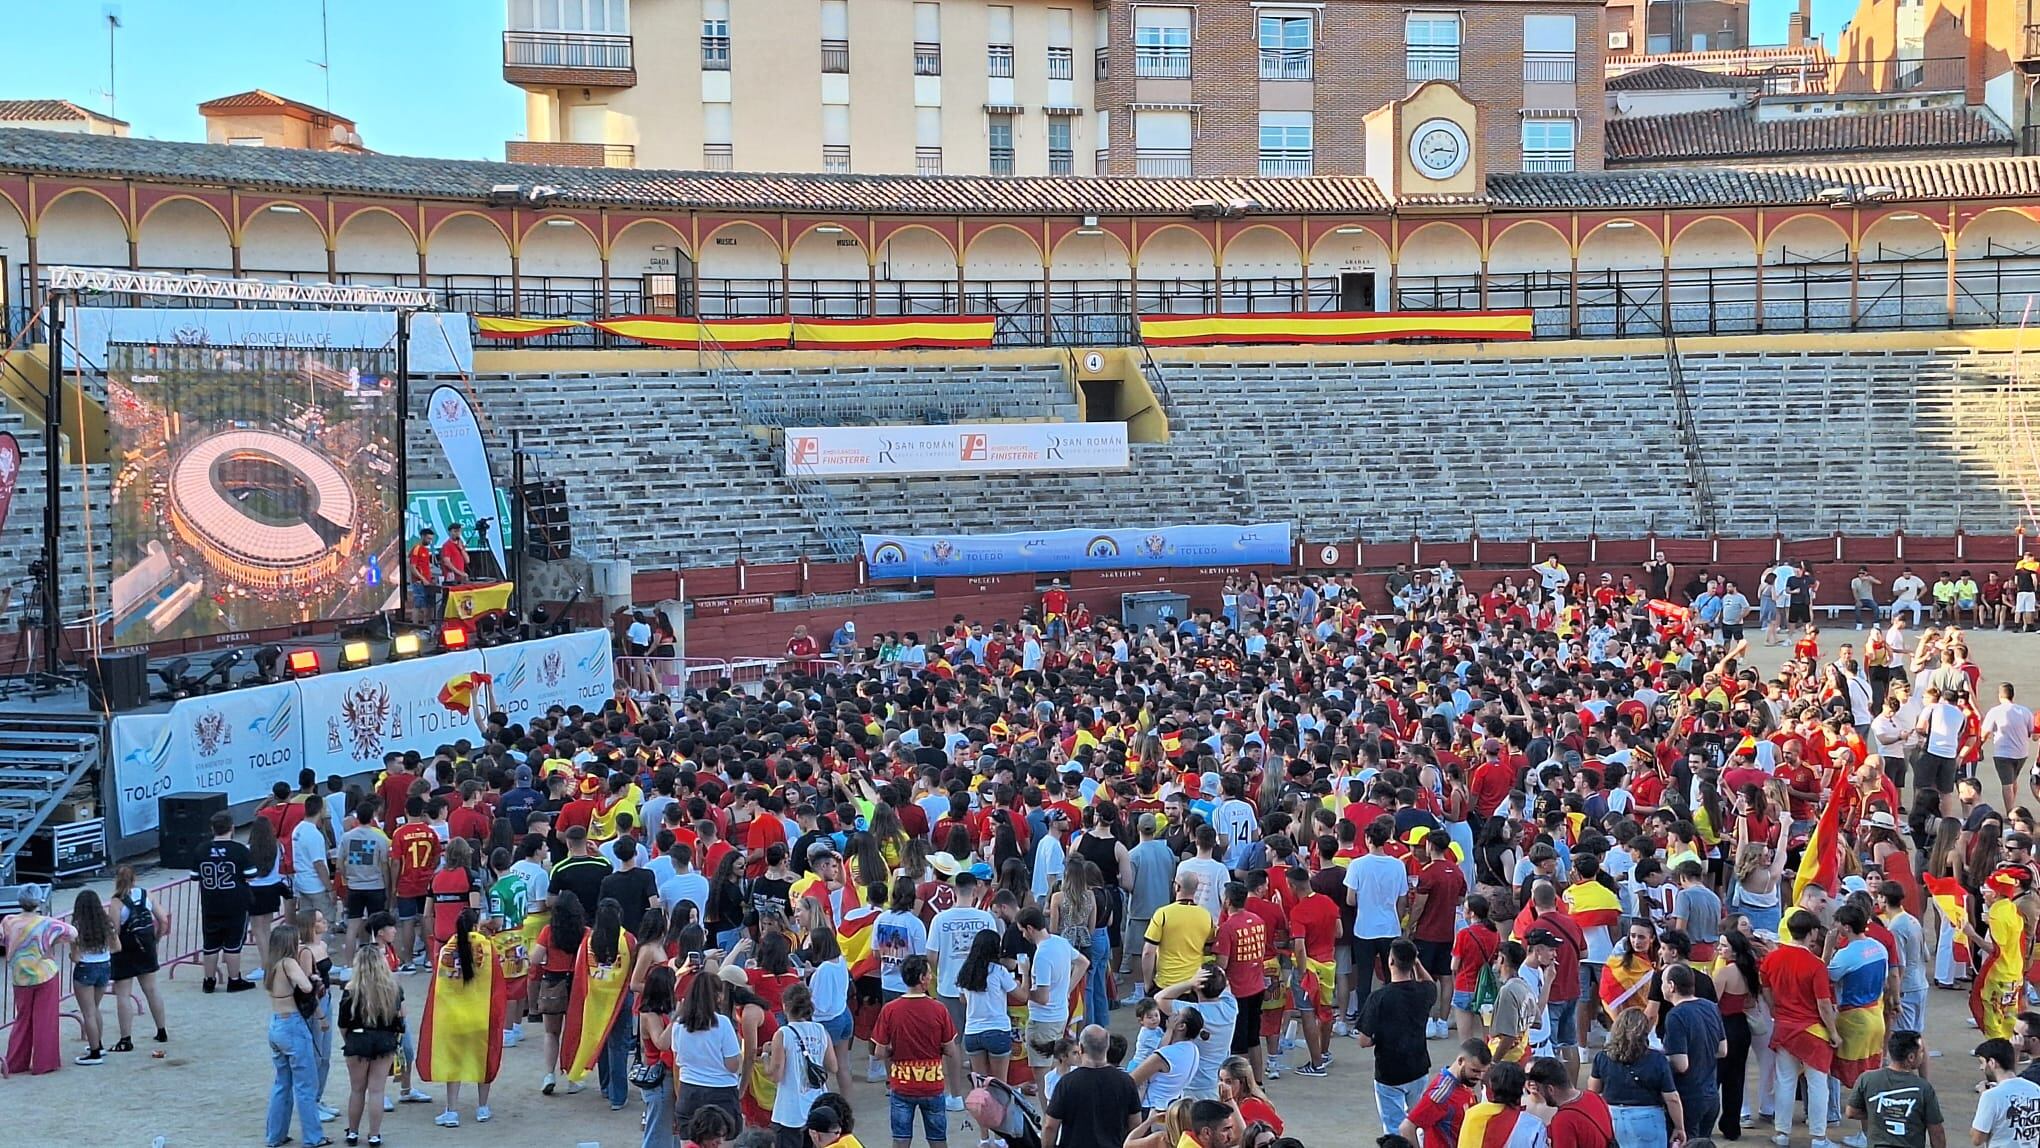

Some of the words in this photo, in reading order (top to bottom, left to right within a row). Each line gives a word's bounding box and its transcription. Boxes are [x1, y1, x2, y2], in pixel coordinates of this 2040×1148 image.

[716, 238, 737, 246] MUSICA
[1090, 356, 1097, 369] 4
[895, 440, 915, 450] SAN
[919, 438, 955, 450] ROMÁN
[1063, 437, 1083, 447] SAN
[1087, 435, 1122, 446] ROMÁN
[822, 454, 871, 465] FINISTERRE
[990, 451, 1040, 461] FINISTERRE
[967, 552, 1004, 561] TOLEDO
[1181, 547, 1217, 556] TOLEDO
[1326, 550, 1333, 560] 4
[578, 682, 605, 700] TOLEDO
[249, 747, 291, 769] TOLEDO
[1231, 820, 1249, 846] 14
[408, 840, 432, 868] 17
[200, 861, 236, 890] 92
[942, 921, 990, 932] SCRATCH
[1236, 928, 1249, 937] YO
[1869, 1087, 1920, 1117] Tommy
